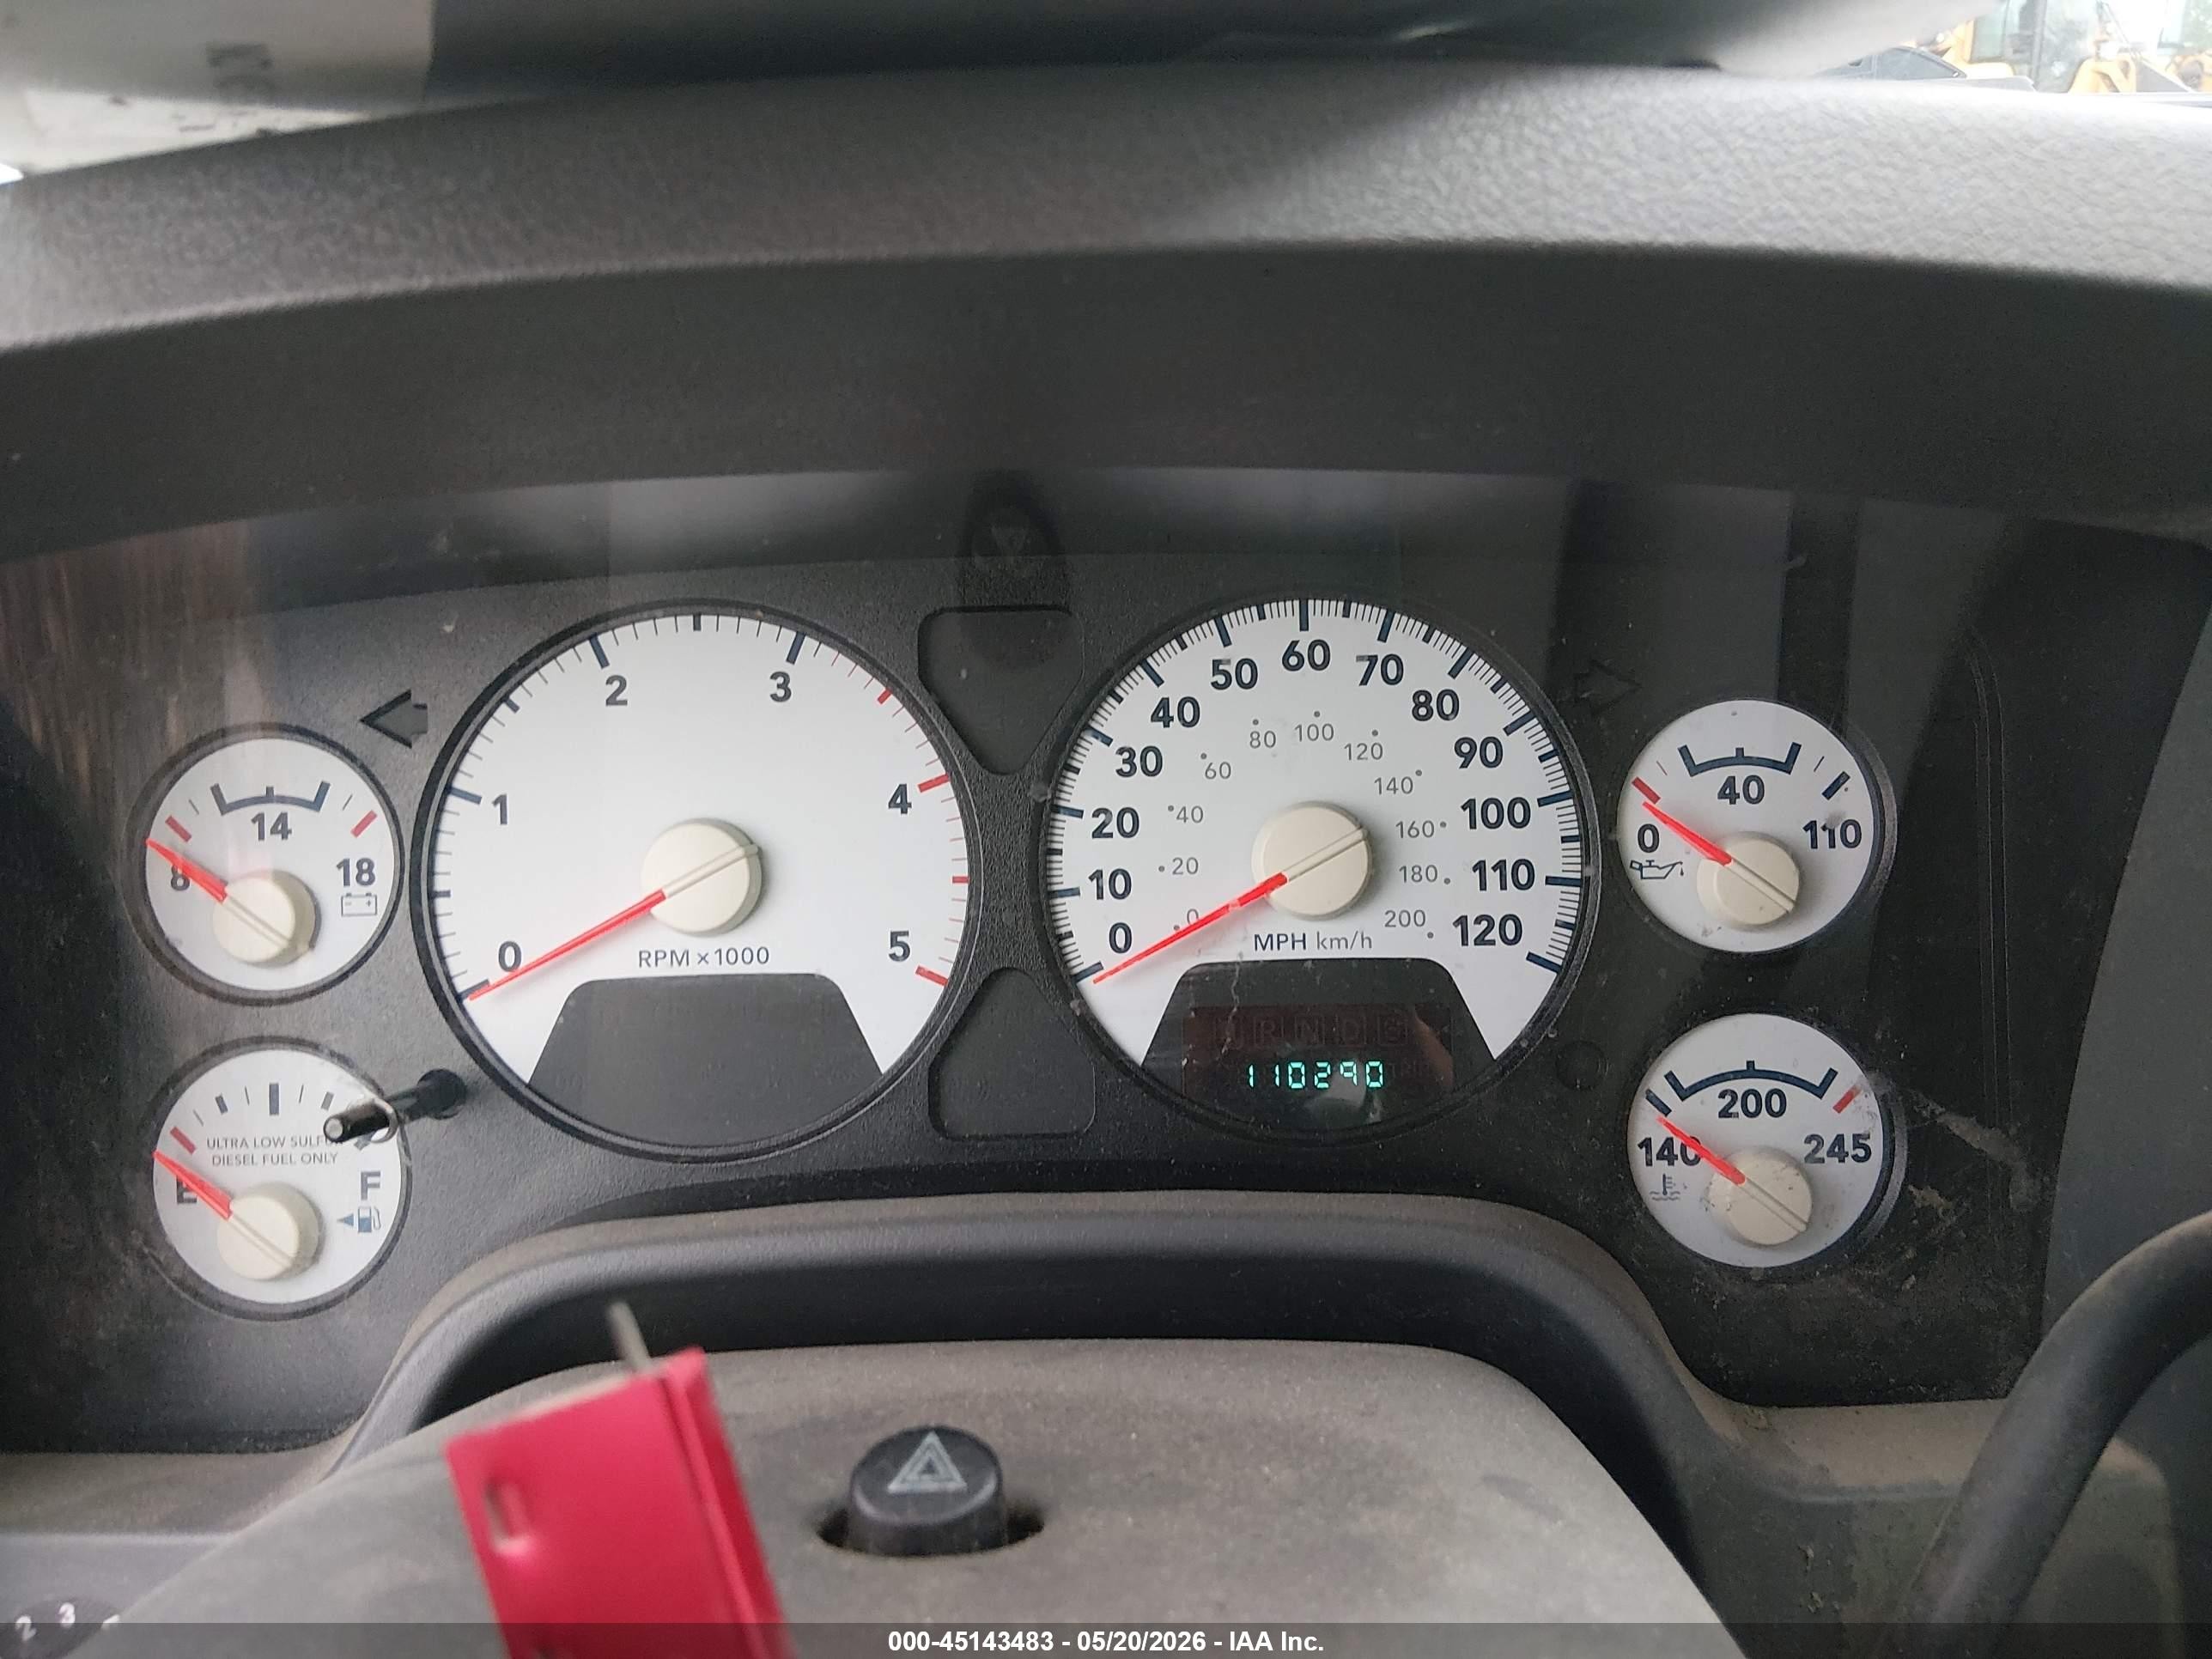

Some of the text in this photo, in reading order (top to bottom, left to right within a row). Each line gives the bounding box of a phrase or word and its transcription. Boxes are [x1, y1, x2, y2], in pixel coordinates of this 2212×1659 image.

[1281, 639, 1331, 672] 60
[1355, 653, 1405, 687] 70
[769, 671, 793, 703] 3
[1210, 658, 1259, 690] 50
[605, 674, 629, 707] 2
[1411, 689, 1461, 722] 80
[1150, 696, 1200, 729] 40
[1249, 730, 1277, 750] 80
[1294, 723, 1335, 744] 100
[1115, 745, 1164, 778] 30
[1344, 742, 1384, 763] 120
[1454, 736, 1504, 769] 90
[1204, 761, 1232, 781] 60
[1374, 775, 1413, 796] 140
[887, 783, 913, 815] 4
[1717, 775, 1765, 805] 40
[491, 793, 508, 826] 1
[1091, 807, 1140, 840] 20
[1176, 805, 1204, 824] 40
[1460, 796, 1531, 830] 100
[251, 811, 293, 842] 14
[1395, 820, 1435, 840] 160
[1636, 823, 1661, 854] 0
[1802, 818, 1863, 850] 110
[336, 857, 376, 888] 18
[1172, 857, 1200, 876] 20
[1399, 864, 1438, 884] 180
[1471, 858, 1536, 891] 110
[1088, 868, 1133, 901] 10
[1384, 909, 1426, 929] 200
[1452, 914, 1523, 947] 120
[888, 930, 912, 962] 5
[1109, 921, 1133, 954] 0
[1254, 931, 1373, 952] MPH km/h
[498, 940, 522, 974] 0
[638, 949, 690, 969] RPM
[1247, 1060, 1384, 1089] 110290
[1717, 1088, 1788, 1119] 200
[206, 1137, 249, 1150] ULTRA
[253, 1136, 286, 1150] LOW
[1637, 1136, 1702, 1168] 140
[1803, 1133, 1873, 1164] 245
[212, 1152, 338, 1167] DIESEL FUEL ONLY
[360, 1170, 382, 1201] F
